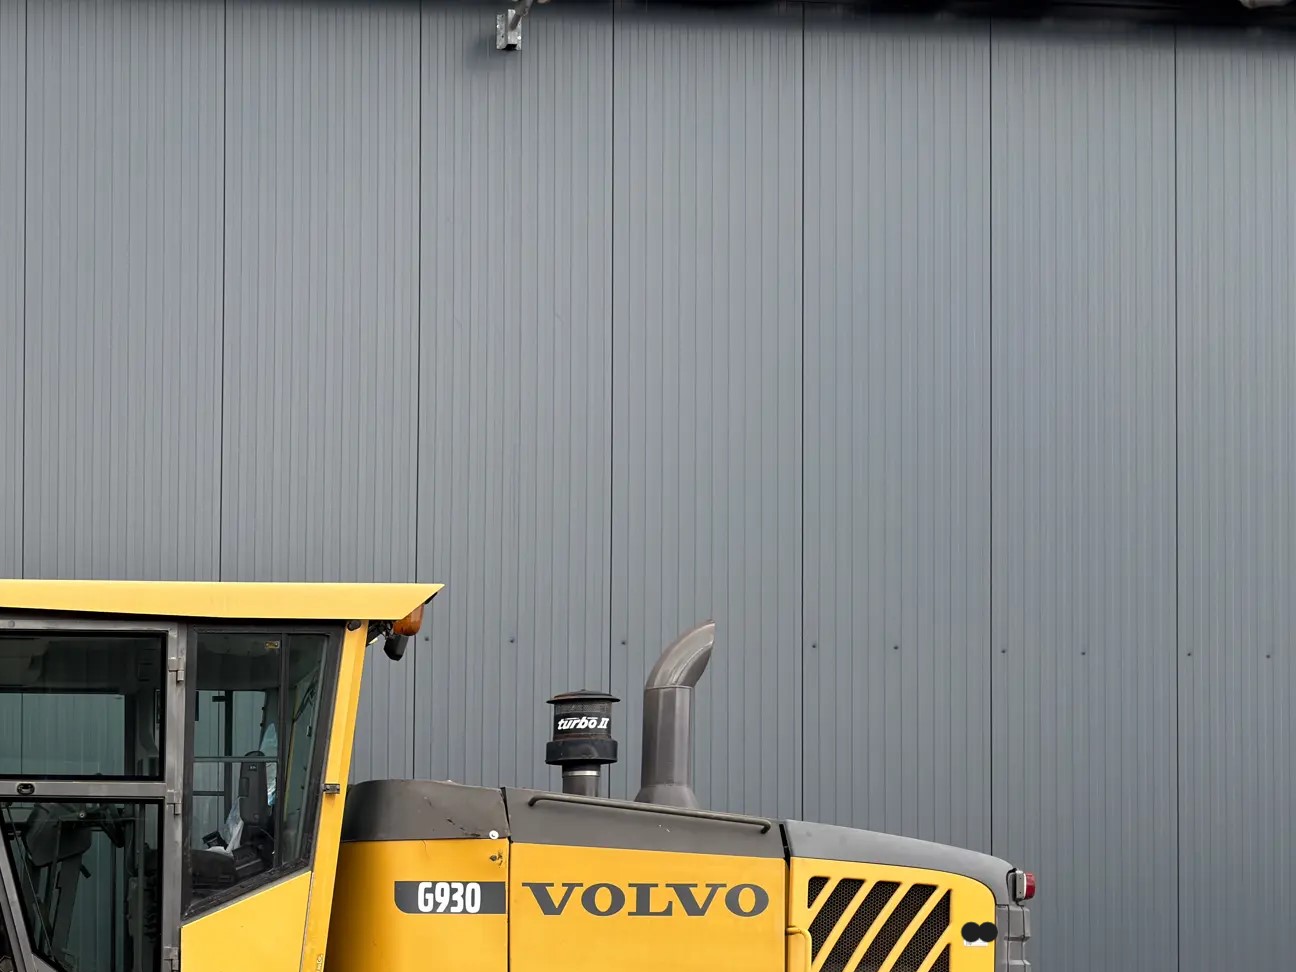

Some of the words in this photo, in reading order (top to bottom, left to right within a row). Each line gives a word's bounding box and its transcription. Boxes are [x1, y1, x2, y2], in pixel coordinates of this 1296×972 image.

[597, 717, 610, 729] II
[417, 881, 481, 914] G930
[522, 882, 769, 917] VOLVO
